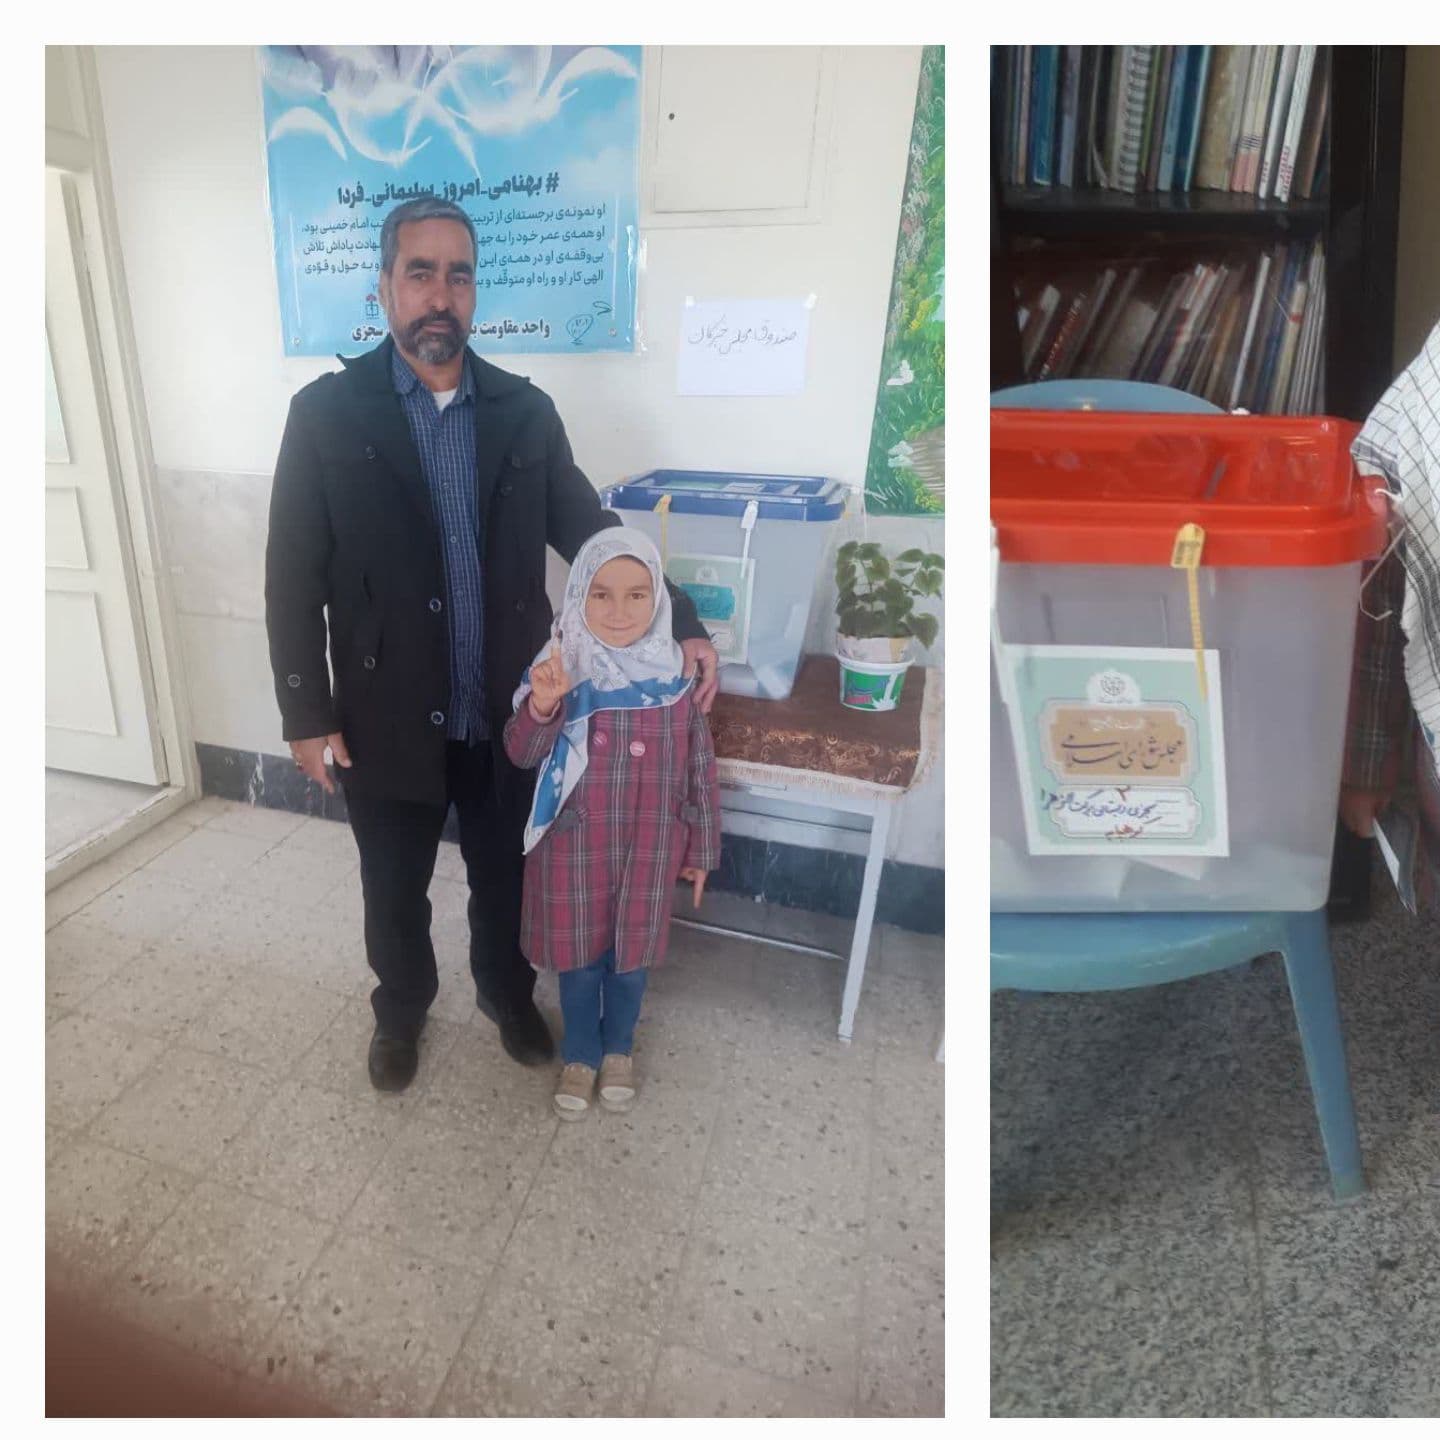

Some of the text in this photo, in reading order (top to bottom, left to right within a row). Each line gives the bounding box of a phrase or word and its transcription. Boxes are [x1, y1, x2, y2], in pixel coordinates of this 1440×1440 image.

[319, 219, 348, 235] خمینی
[350, 217, 368, 231] امام
[516, 231, 538, 245] خود
[583, 269, 604, 285] الهی
[479, 319, 519, 339] مقاومت
[522, 318, 550, 338] واحد
